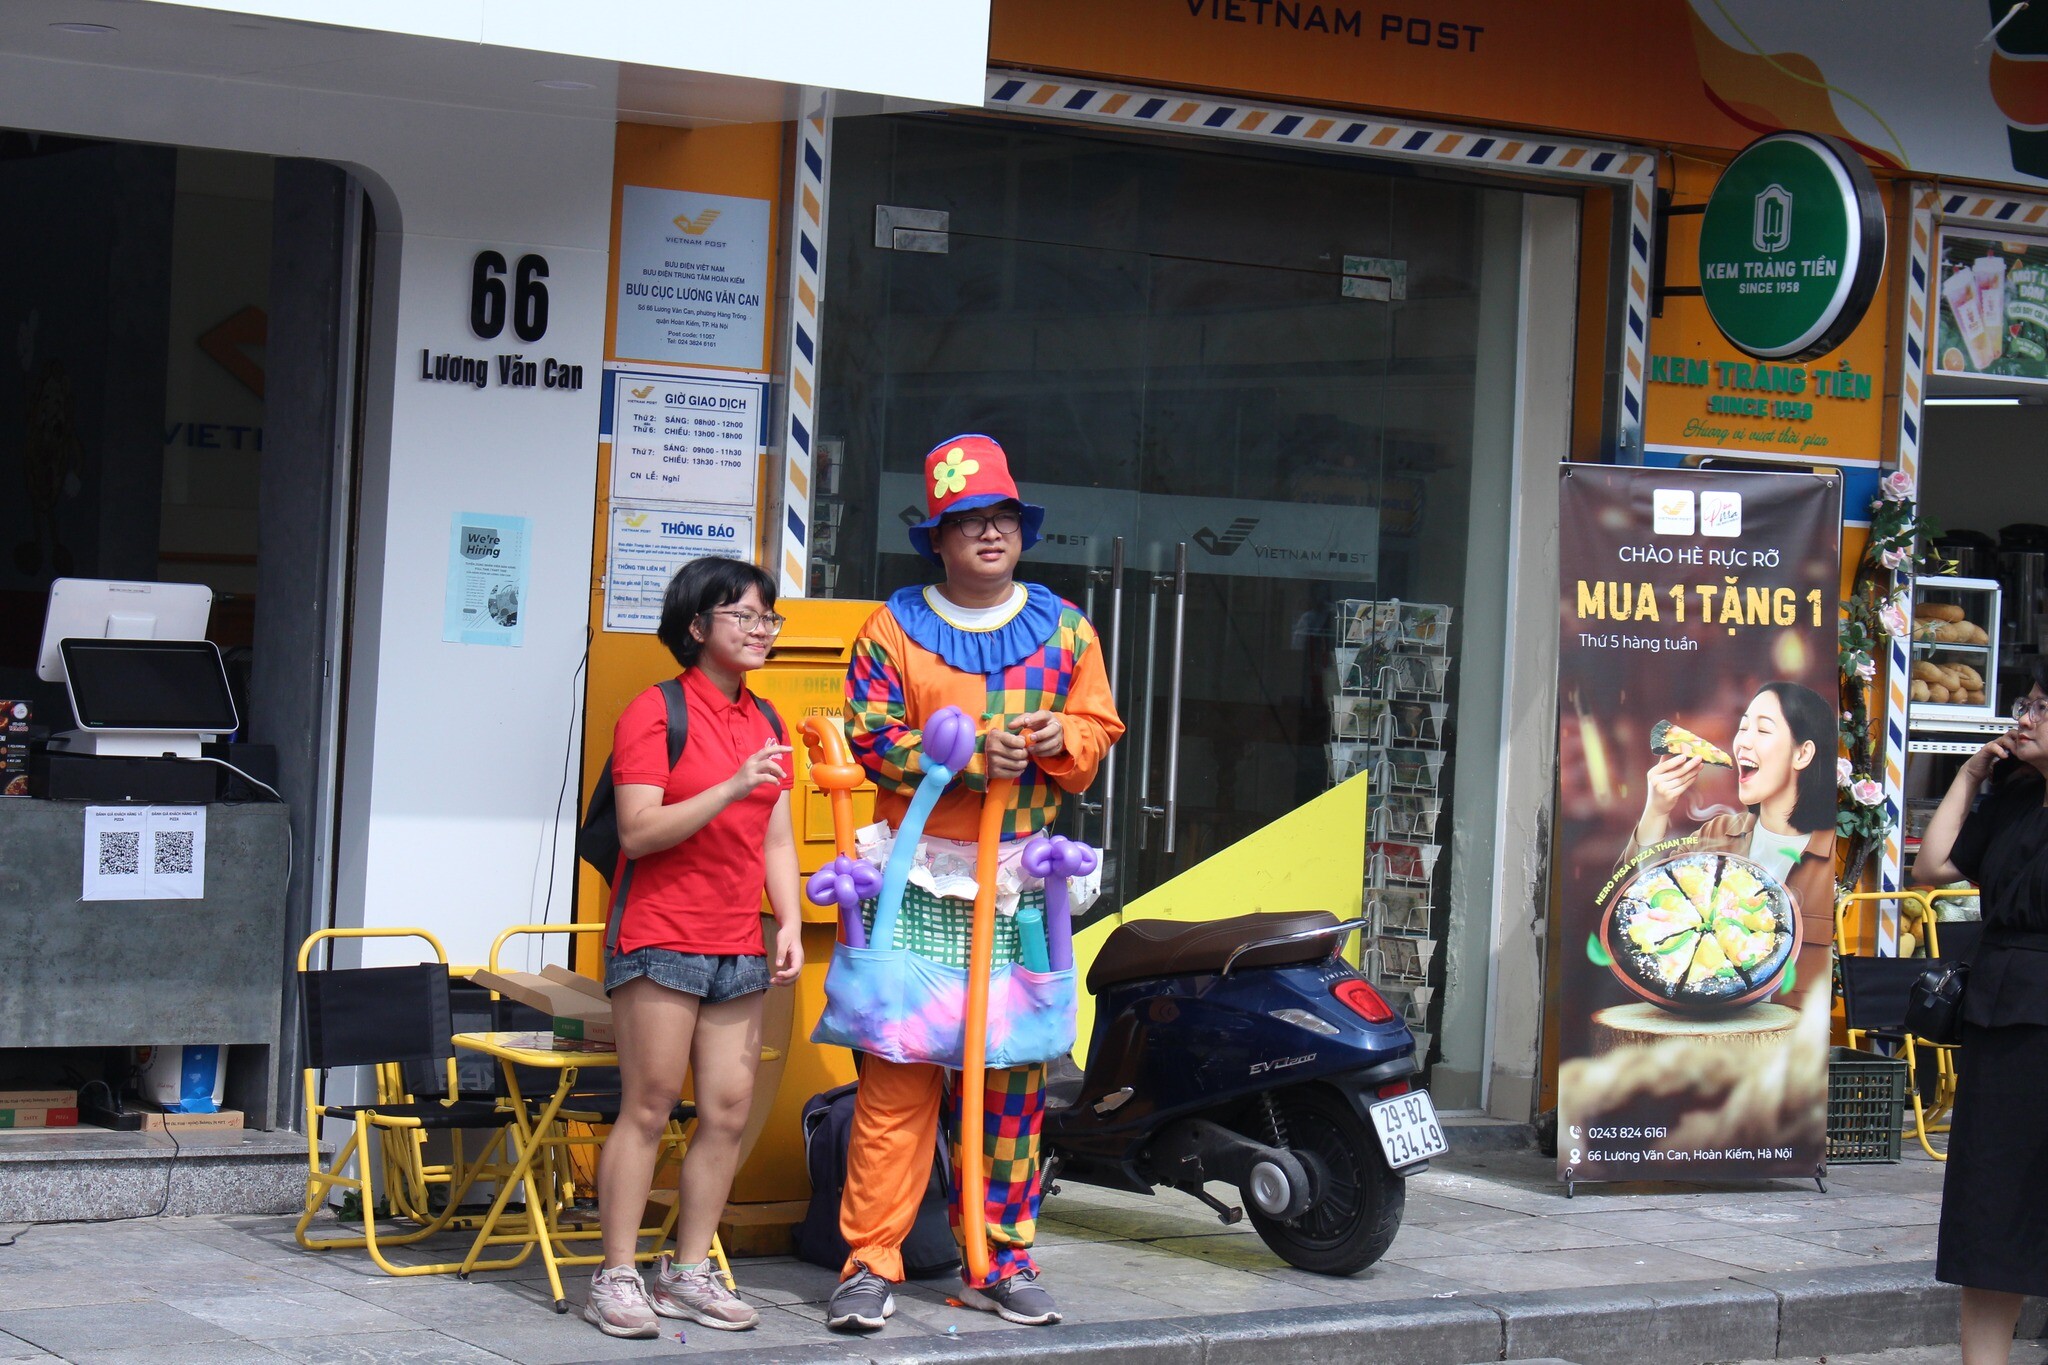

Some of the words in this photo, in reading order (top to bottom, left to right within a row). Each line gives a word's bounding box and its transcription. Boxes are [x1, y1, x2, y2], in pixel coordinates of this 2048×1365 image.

[1187, 0, 1361, 37] VIETNAM
[1381, 14, 1485, 52] POST
[665, 236, 702, 246] VIETNAM
[705, 240, 727, 248] POST
[1706, 262, 1739, 279] KEM
[1744, 256, 1796, 278] TRÀNG
[1801, 254, 1837, 277] TIỀN
[674, 272, 696, 280] TRUNG
[470, 249, 550, 343] 66
[626, 282, 648, 296] BƯU
[651, 285, 674, 300] CỤC
[676, 286, 713, 302] LƯƠNG
[715, 289, 736, 304] VĂN
[738, 293, 759, 306] CAN
[1739, 282, 1773, 294] SINCE
[1776, 281, 1800, 293] 1958
[421, 347, 488, 390] Lương
[498, 353, 538, 389] Văn
[543, 356, 584, 390] Can
[1649, 355, 1709, 386] KEM
[1813, 359, 1872, 400] TIỀN
[665, 392, 686, 404] GIỜ
[688, 395, 716, 407] GIAO
[720, 397, 746, 410] DỊCH
[1708, 395, 1769, 417] SINCE
[1771, 400, 1814, 420] 1958
[634, 414, 648, 422] Thứ
[665, 415, 690, 424] SÁNG:
[694, 418, 716, 427] 08h00
[722, 420, 744, 428] 12h00
[161, 422, 263, 452] VIET
[633, 426, 648, 434] Thứ
[694, 430, 715, 438] 13h00
[722, 432, 742, 440] 18h00
[1803, 432, 1829, 450] gian
[632, 448, 646, 456] Thứ
[664, 443, 688, 452] SÁNG:
[692, 446, 714, 454] 09h00
[720, 448, 742, 456] 11h30
[692, 458, 714, 466] 13h30
[720, 460, 742, 468] 17h00
[661, 520, 703, 536] THÔNG
[708, 523, 735, 538] BÁO
[468, 533, 500, 545] We're
[1046, 533, 1089, 546] POST
[466, 545, 500, 558] Hiring
[1255, 546, 1322, 561] VIETNAM
[1328, 552, 1368, 564] POST
[1618, 543, 1673, 565] CHÀO
[1678, 546, 1704, 565] HÈ
[1709, 548, 1748, 570] RỰC
[1752, 548, 1781, 568] RỠ
[1577, 579, 1660, 622] MUA
[1668, 583, 1685, 623] 1
[1695, 575, 1796, 636] TẶNG
[1806, 588, 1822, 627] 1
[1579, 632, 1608, 648] Thứ
[1610, 634, 1620, 648] 5
[1622, 634, 1660, 652] hàng
[1664, 636, 1698, 651] tuần
[801, 706, 843, 717] VIETNA
[1595, 881, 1614, 906] NERO
[1612, 864, 1632, 882] PISA
[1630, 848, 1656, 866] PIZZA
[1655, 838, 1680, 852] THAN
[1681, 836, 1699, 846] TRE
[1380, 1097, 1427, 1133] 29-B2
[1588, 1127, 1617, 1139] 0243
[1619, 1127, 1642, 1138] 824
[1644, 1127, 1667, 1138] 6161
[1387, 1124, 1442, 1163] 234.49
[1587, 1151, 1602, 1162] 66
[1604, 1150, 1640, 1163] Lương
[1642, 1150, 1664, 1161] Văn
[1666, 1150, 1691, 1162] Can,
[1694, 1149, 1722, 1160] Hoàn
[1725, 1148, 1755, 1161] Kiếm,
[1758, 1148, 1772, 1159] Hà
[1774, 1147, 1793, 1160] Nội
